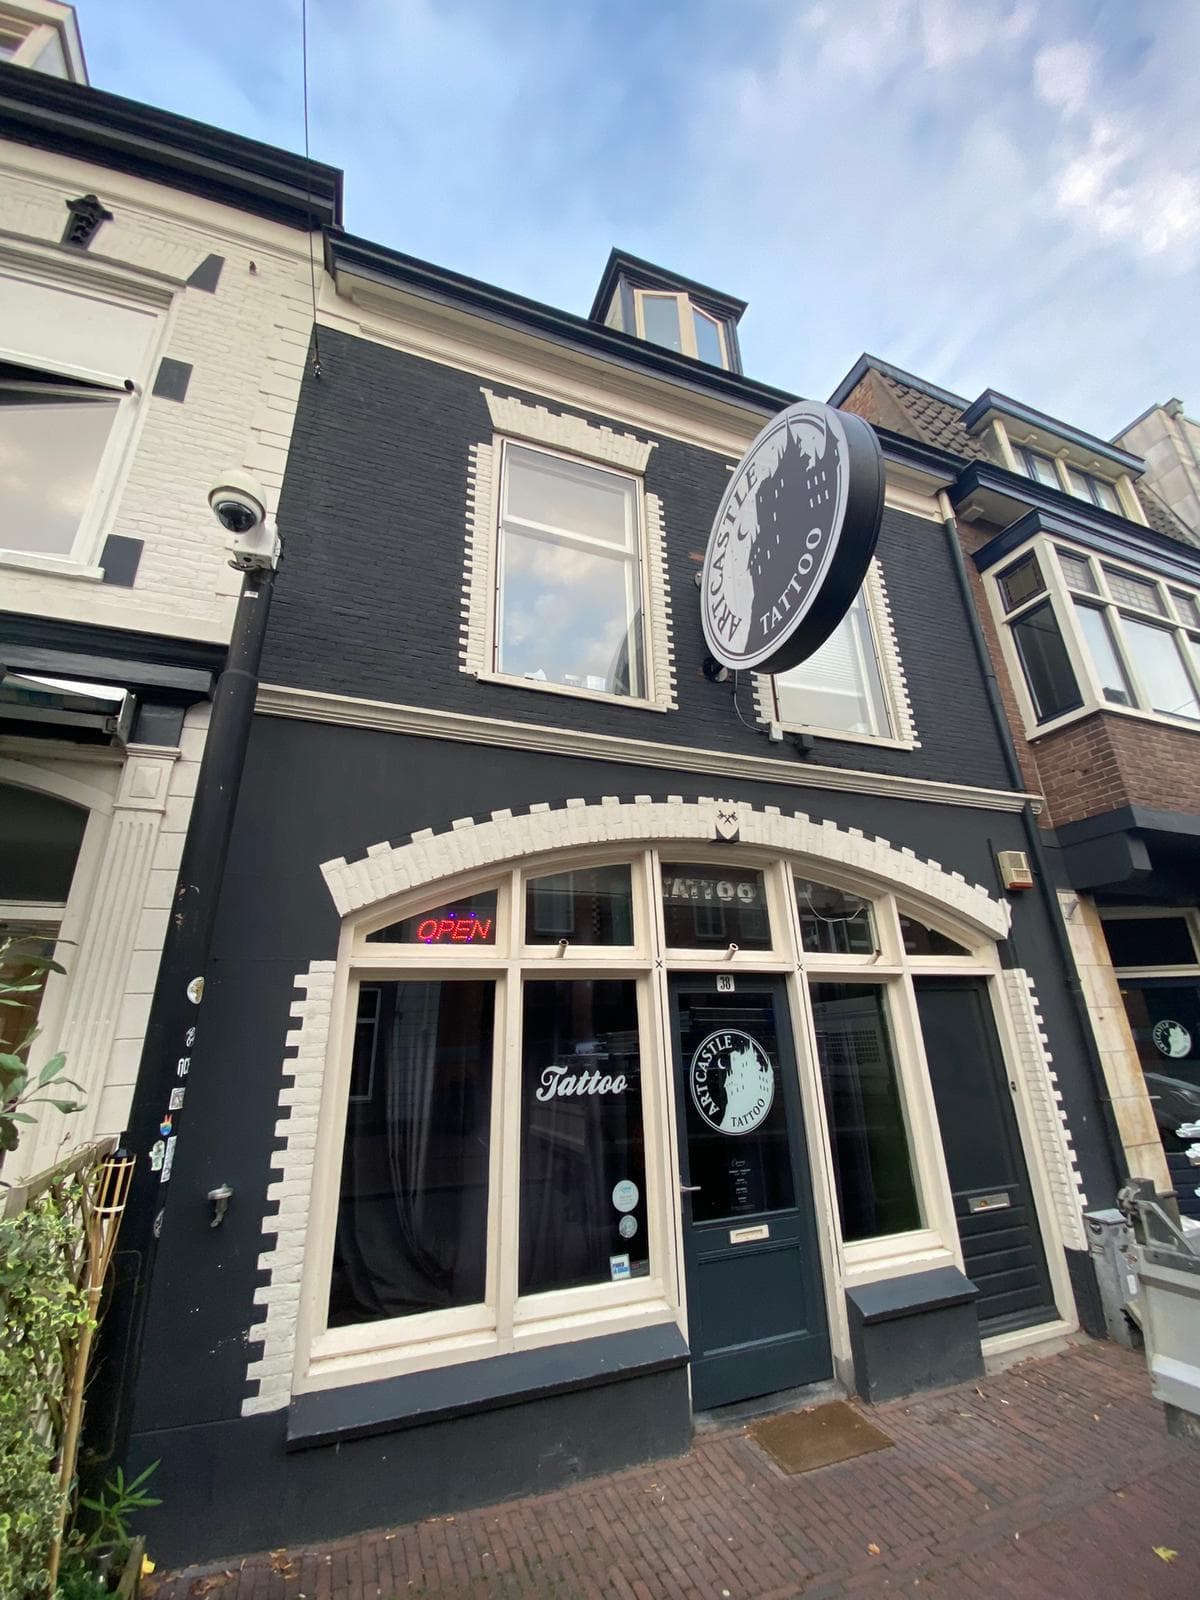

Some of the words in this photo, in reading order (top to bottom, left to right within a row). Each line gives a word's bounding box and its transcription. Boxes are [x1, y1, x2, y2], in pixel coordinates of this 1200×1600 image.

[710, 461, 760, 642] ARTCASTLE
[759, 527, 822, 636] TATTOO
[417, 919, 492, 940] OPEN
[720, 976, 731, 990] 38
[535, 1065, 628, 1102] Tattoo
[695, 1035, 733, 1116] ARTCASTLE
[731, 1098, 765, 1127] TATTOO
